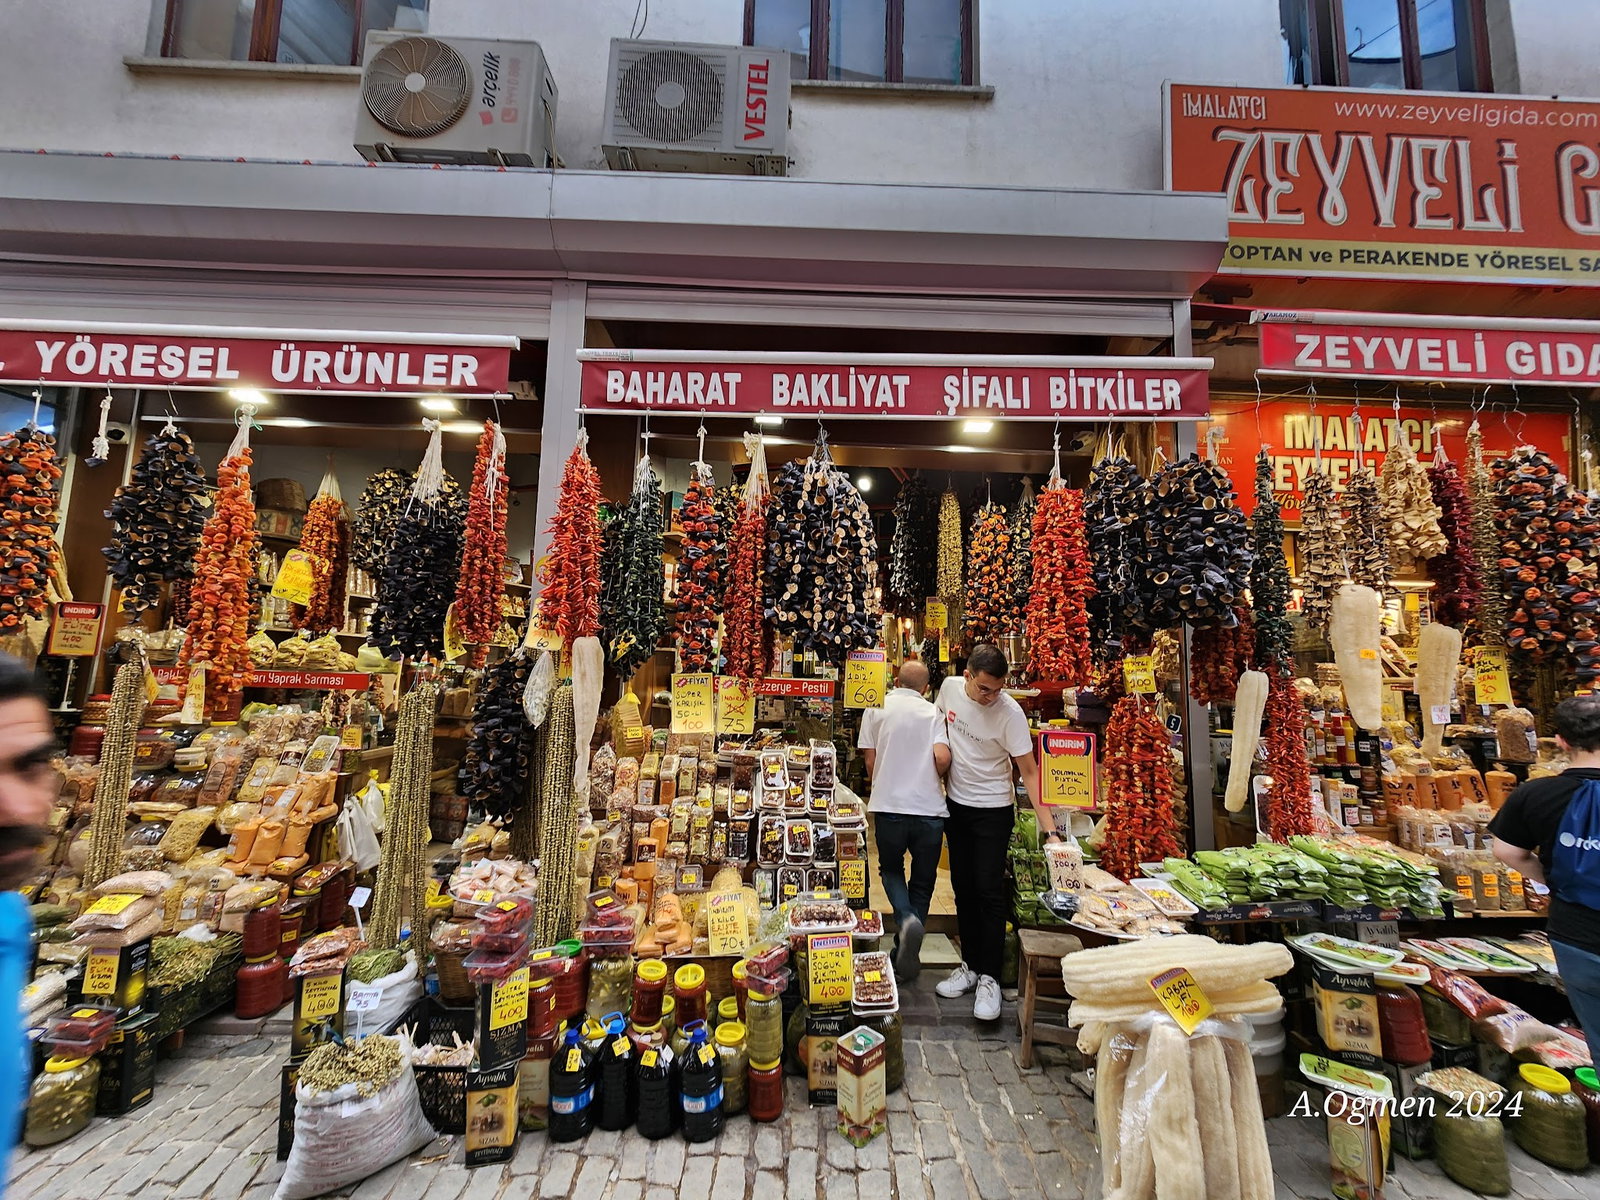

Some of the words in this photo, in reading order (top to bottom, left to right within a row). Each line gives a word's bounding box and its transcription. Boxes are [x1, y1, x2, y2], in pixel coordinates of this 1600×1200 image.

[482, 52, 500, 107] arçelik
[744, 59, 770, 141] VESTEL
[1334, 101, 1598, 128] www.zeyveligida.com
[1224, 244, 1302, 263] OPTAN
[1309, 250, 1333, 264] ve
[1339, 249, 1469, 268] PERAKENDE
[1475, 251, 1573, 271] YÖRESEL
[1294, 332, 1487, 373] ZEYVELİ
[35, 335, 239, 379] YÖRESEL
[271, 343, 479, 387] ÜRÜNLER
[606, 370, 741, 405] BAHARAT
[772, 367, 910, 407] BAKLİYAT
[943, 367, 1030, 416] ŞİFALI
[1049, 369, 1181, 411] BİTKİLER
[268, 673, 301, 686] Yaprak
[304, 674, 344, 686] Sarması
[1129, 678, 1151, 689] 100
[760, 682, 792, 695] ezerye
[801, 682, 829, 693] Pestil
[854, 685, 877, 704] 60
[682, 719, 704, 730] 100
[722, 717, 746, 733] 75
[1049, 738, 1085, 749] İNDİRİM
[1057, 783, 1076, 796] 10
[723, 893, 742, 901] FİYAT
[92, 981, 110, 990] 400
[1160, 977, 1195, 1002] KABAK
[1331, 974, 1371, 989] Ayvalık
[821, 985, 846, 998] 400
[499, 1006, 522, 1020] 400
[1181, 999, 1200, 1019] 100
[489, 1022, 523, 1039] SIZMA
[811, 1021, 840, 1032] Ayvalık
[473, 1071, 508, 1087] Ayvalık
